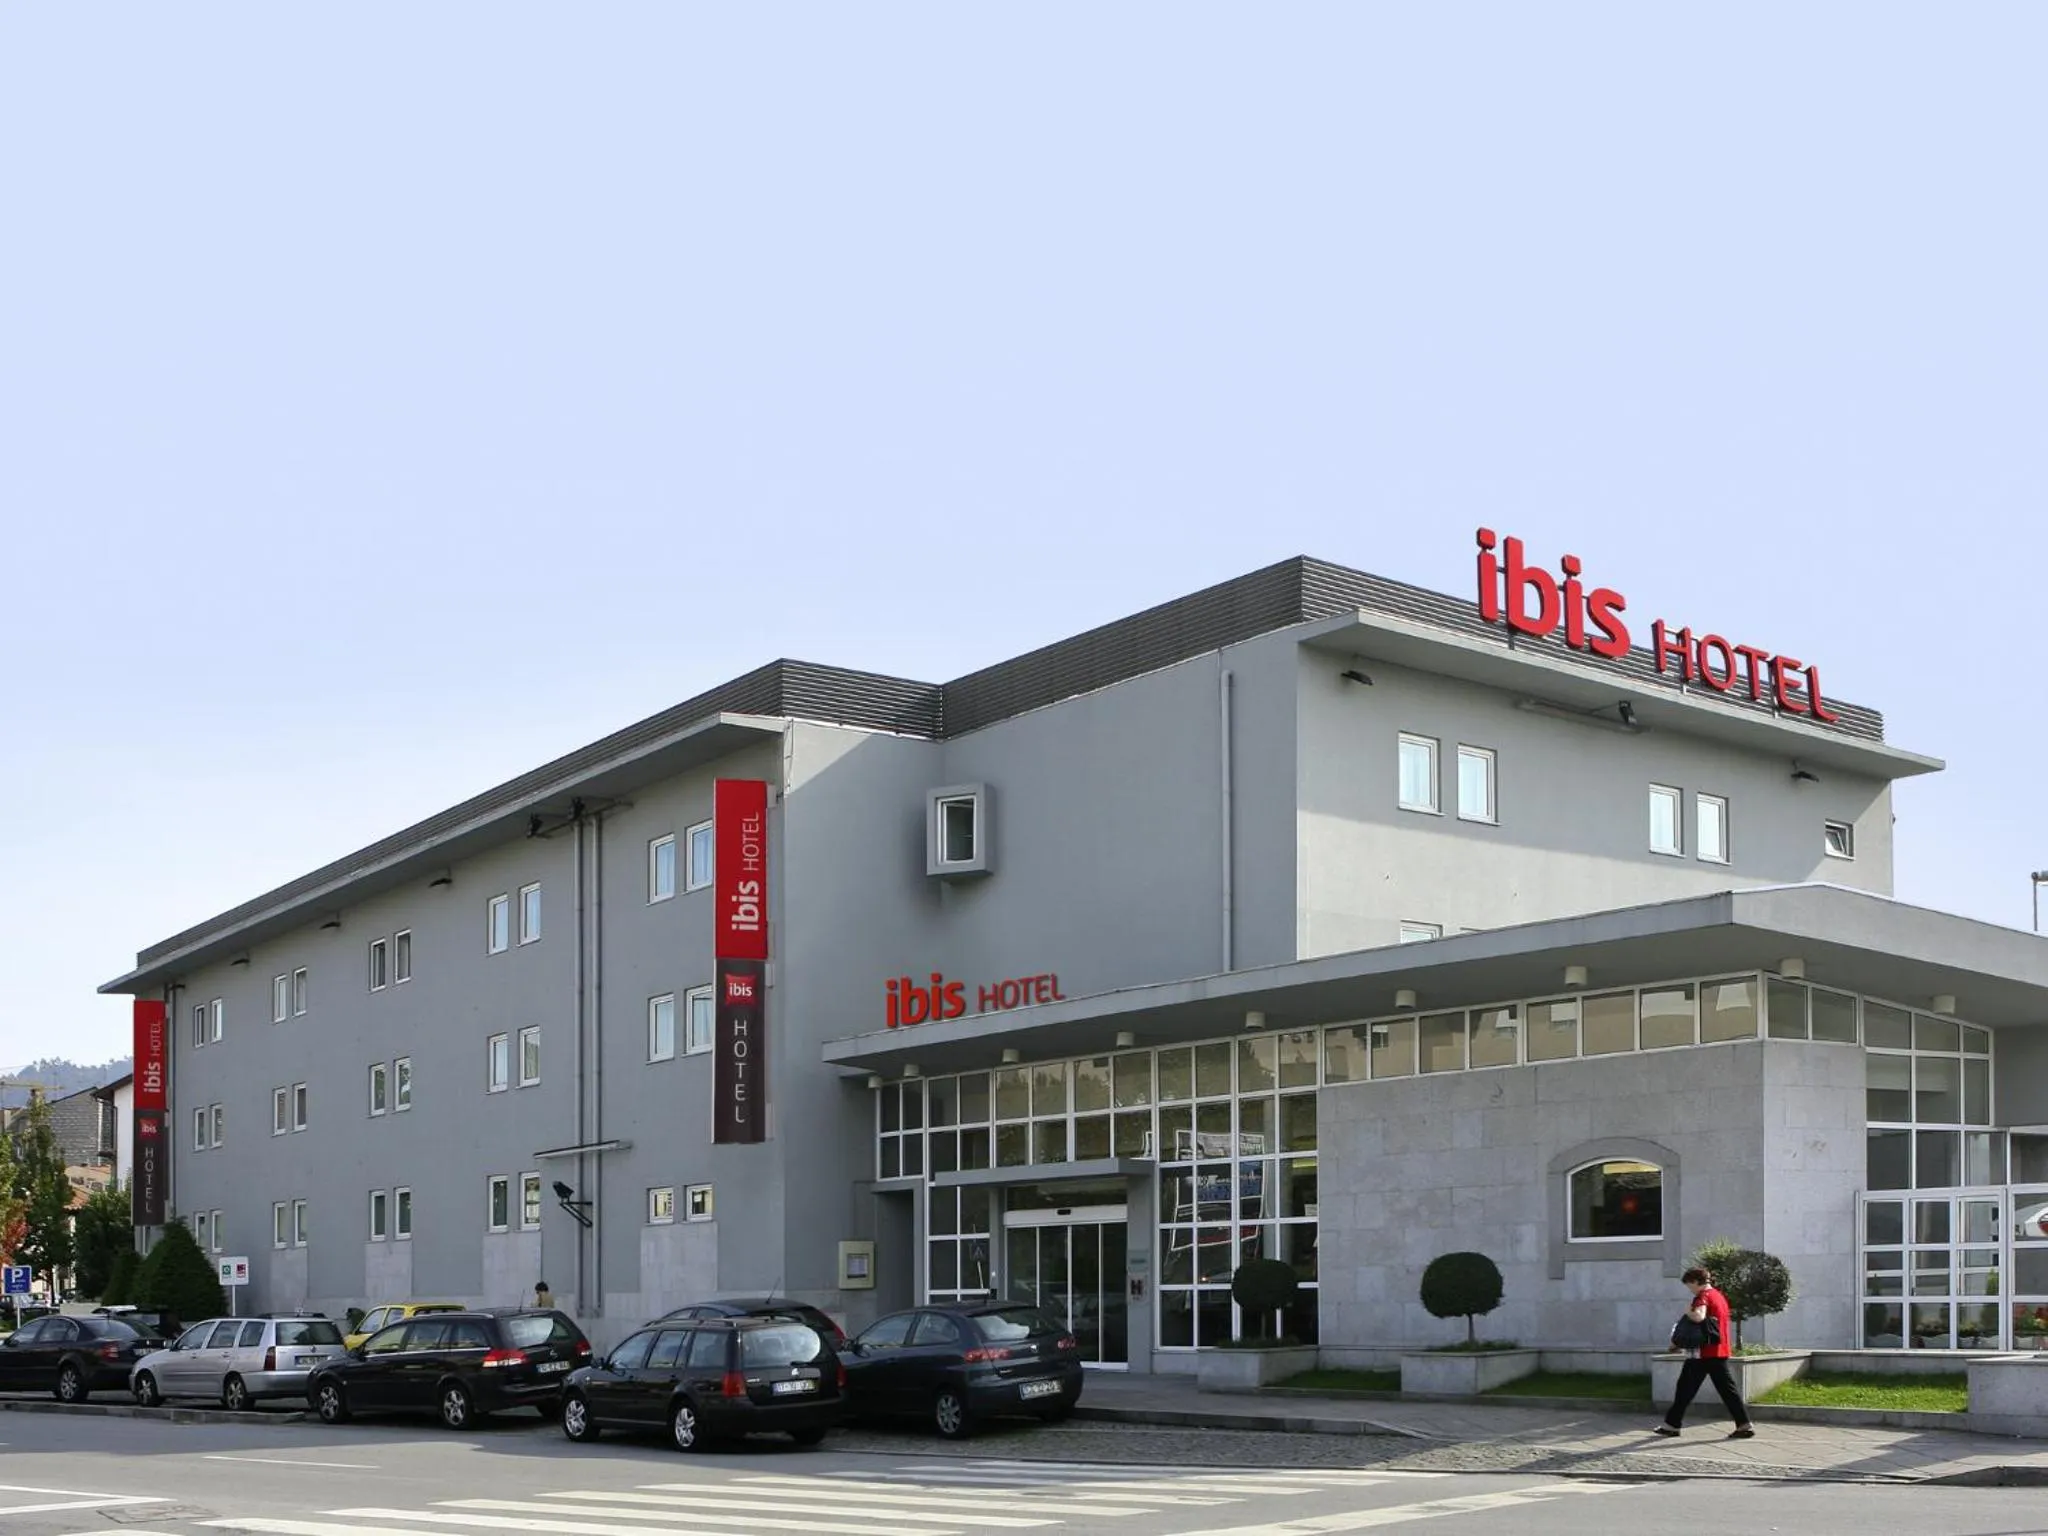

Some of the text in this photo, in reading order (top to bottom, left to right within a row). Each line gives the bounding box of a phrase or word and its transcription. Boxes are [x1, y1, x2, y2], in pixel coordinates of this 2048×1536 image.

[1476, 527, 1839, 723] ibis HOTEL
[731, 813, 759, 931] ibis HOTEL
[729, 982, 752, 997] ibis
[885, 972, 1066, 1029] ibis HOTEL
[143, 1021, 161, 1093] ibis HOTEL
[733, 1018, 748, 1124] HOTEL
[141, 1122, 157, 1134] ibis
[144, 1147, 154, 1214] HOTEL
[12, 1268, 23, 1283] P
